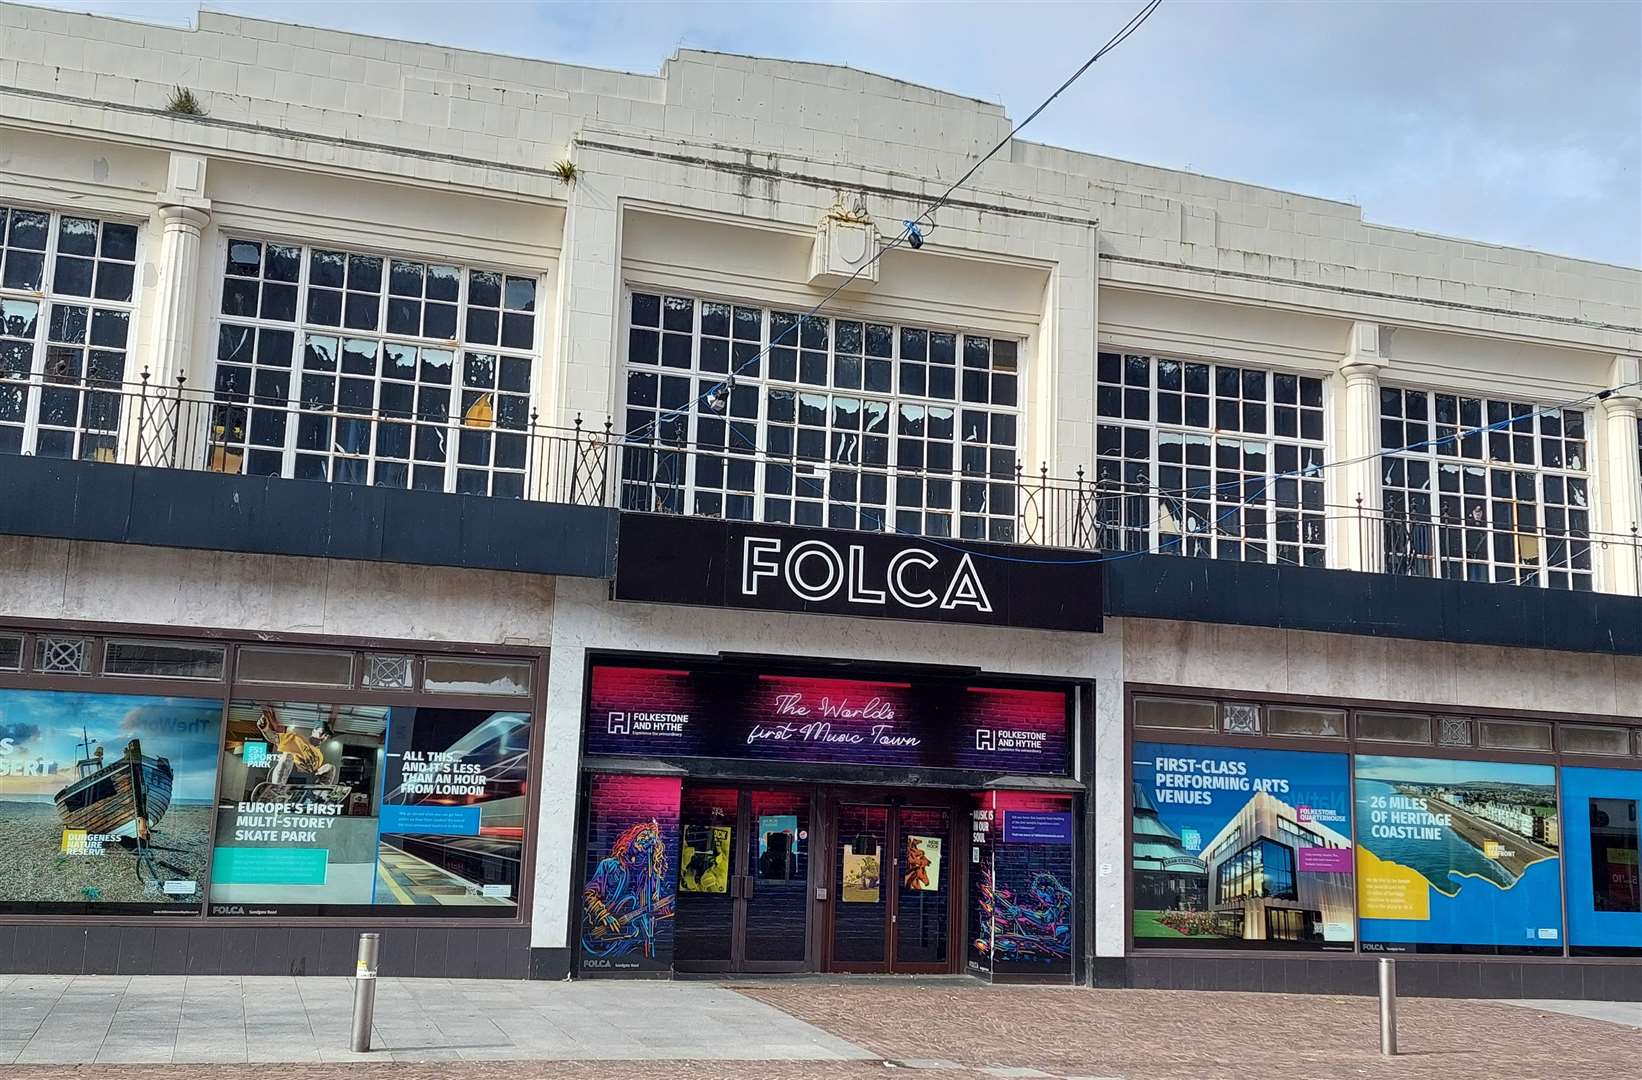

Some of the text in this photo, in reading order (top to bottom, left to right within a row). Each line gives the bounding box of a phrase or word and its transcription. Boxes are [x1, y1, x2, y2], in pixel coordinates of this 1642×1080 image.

[741, 536, 993, 612] FOLCA
[776, 693, 811, 715] The
[633, 713, 689, 723] FOLKESTONE
[633, 722, 683, 731] AND HYTHE
[747, 722, 921, 746] first Music Town
[998, 730, 1047, 740] FOLKESTONE
[998, 739, 1042, 748] AND HYTHE
[247, 753, 283, 762] SPORTS
[403, 751, 425, 761] ALL
[402, 762, 427, 772] AND
[453, 764, 481, 774] LESS
[1155, 757, 1247, 775] FIRST-CLASS
[401, 773, 487, 785] THAN AN HOUR
[1155, 774, 1289, 793] PERFORMING ARTS
[400, 784, 485, 796] FROM LONDON
[1155, 789, 1212, 805] VENUES
[238, 802, 344, 815] EUROPE'S FIRST
[1370, 796, 1428, 811] 26 MILES
[1299, 808, 1337, 816] FOLKESTONE
[1371, 810, 1452, 826] OF HERITAGE
[235, 816, 335, 829] MULTI-STOREY
[68, 833, 122, 842] DUNGENESS
[234, 830, 317, 842] SKATE PARK
[1371, 825, 1442, 840] COASTLINE
[67, 841, 103, 849] NATURE
[66, 848, 107, 856] RESERVE
[212, 906, 245, 915] FOLCA
[583, 960, 611, 968] FOLCA
